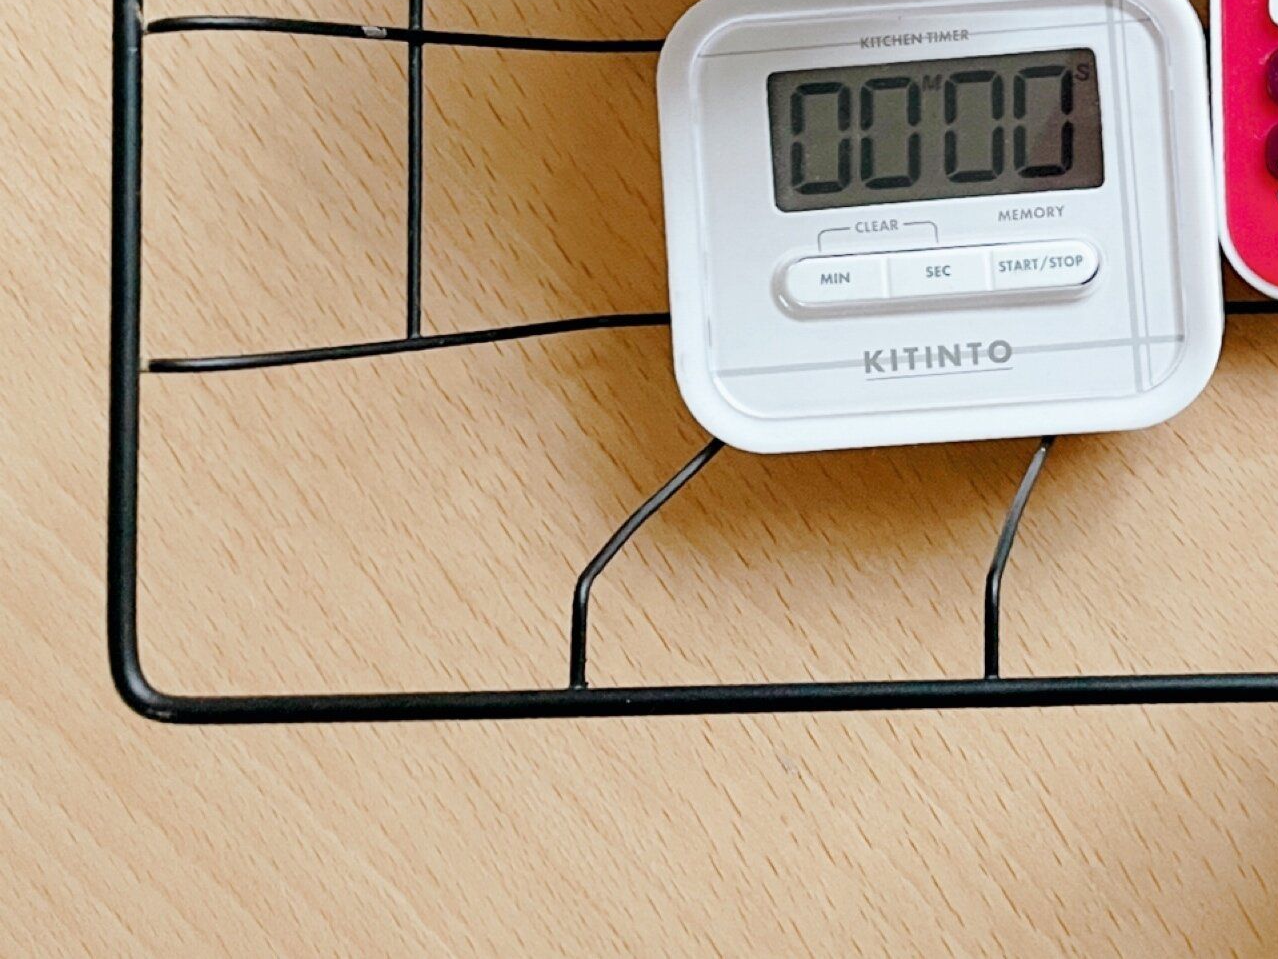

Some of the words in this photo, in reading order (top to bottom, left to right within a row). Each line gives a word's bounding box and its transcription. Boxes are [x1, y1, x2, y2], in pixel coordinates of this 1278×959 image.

[860, 33, 923, 49] KITCHEN
[926, 29, 970, 44] TIMER
[998, 205, 1065, 222] MEMORY
[855, 218, 899, 234] CLEAR
[820, 272, 851, 285] MIN
[925, 264, 951, 278] SEC
[864, 339, 1013, 375] KITINTO
